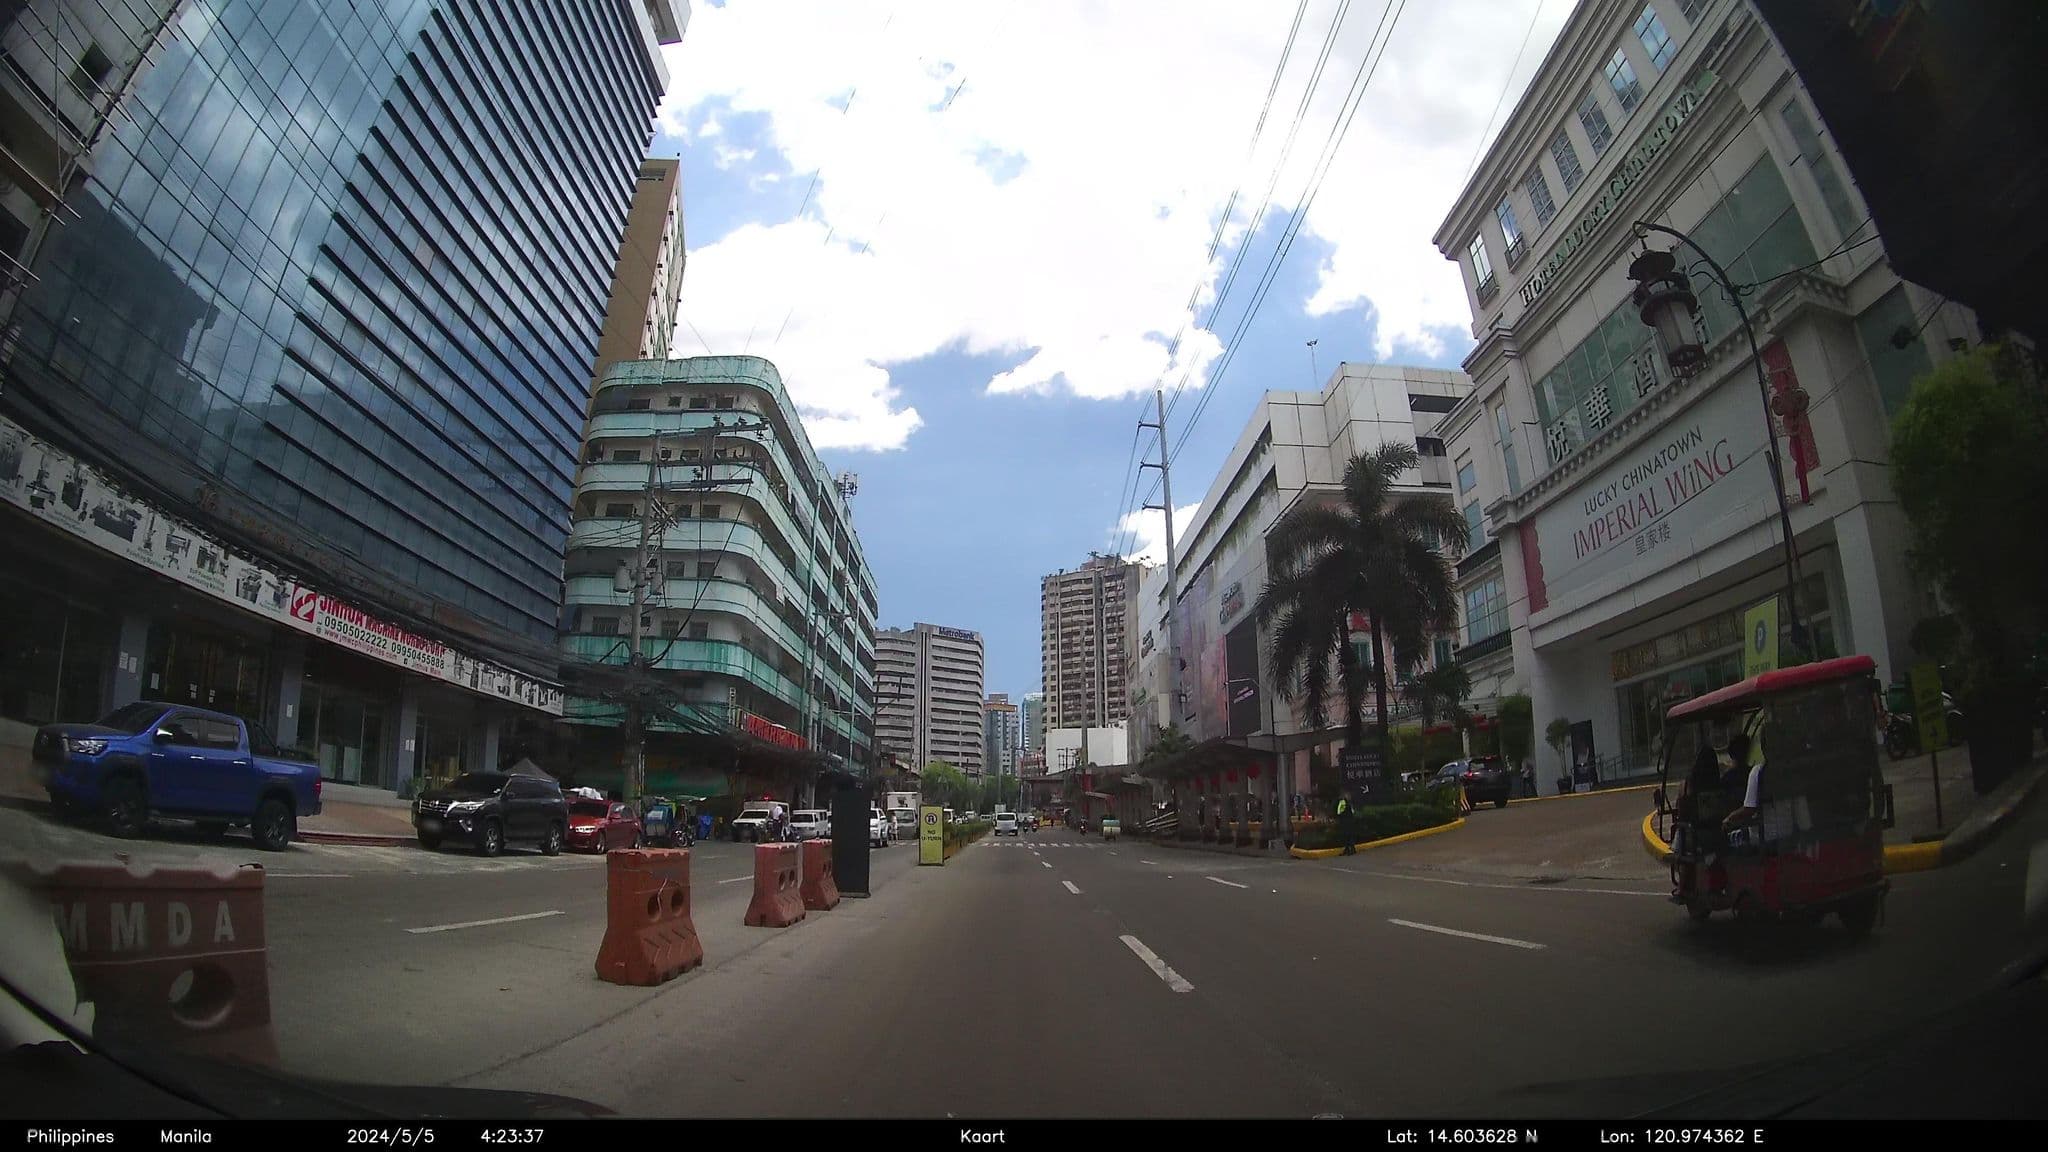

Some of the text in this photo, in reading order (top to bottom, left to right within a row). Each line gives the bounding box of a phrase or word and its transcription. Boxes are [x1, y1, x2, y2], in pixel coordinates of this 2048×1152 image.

[1564, 193, 1613, 260] LUCKY
[1584, 423, 1704, 516] LUCKY CHINATOWN
[1573, 486, 1664, 560] IMPERIAL
[1634, 520, 1672, 556] 皇家楼
[324, 616, 445, 670] 09505022222 09950455888
[938, 626, 976, 640] Metrobank
